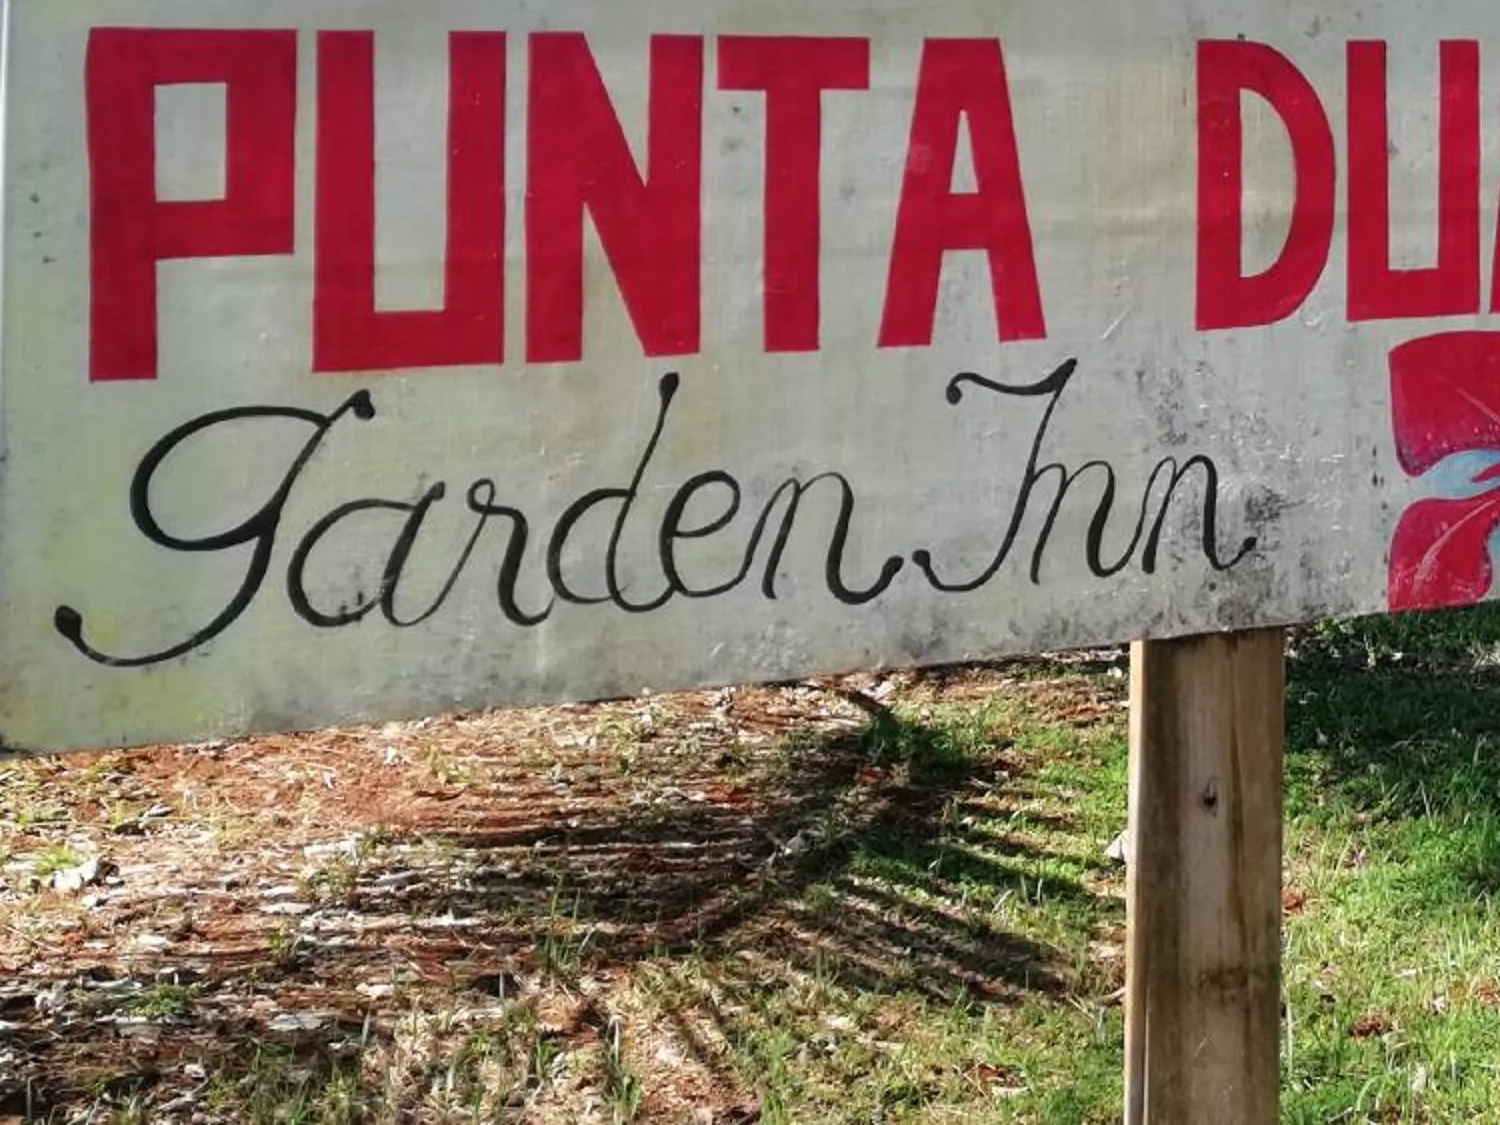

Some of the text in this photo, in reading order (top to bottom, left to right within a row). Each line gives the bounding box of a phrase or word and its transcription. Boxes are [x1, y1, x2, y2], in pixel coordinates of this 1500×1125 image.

[86, 27, 1046, 382] PUNTA
[55, 358, 1258, 667] Garden Inn
